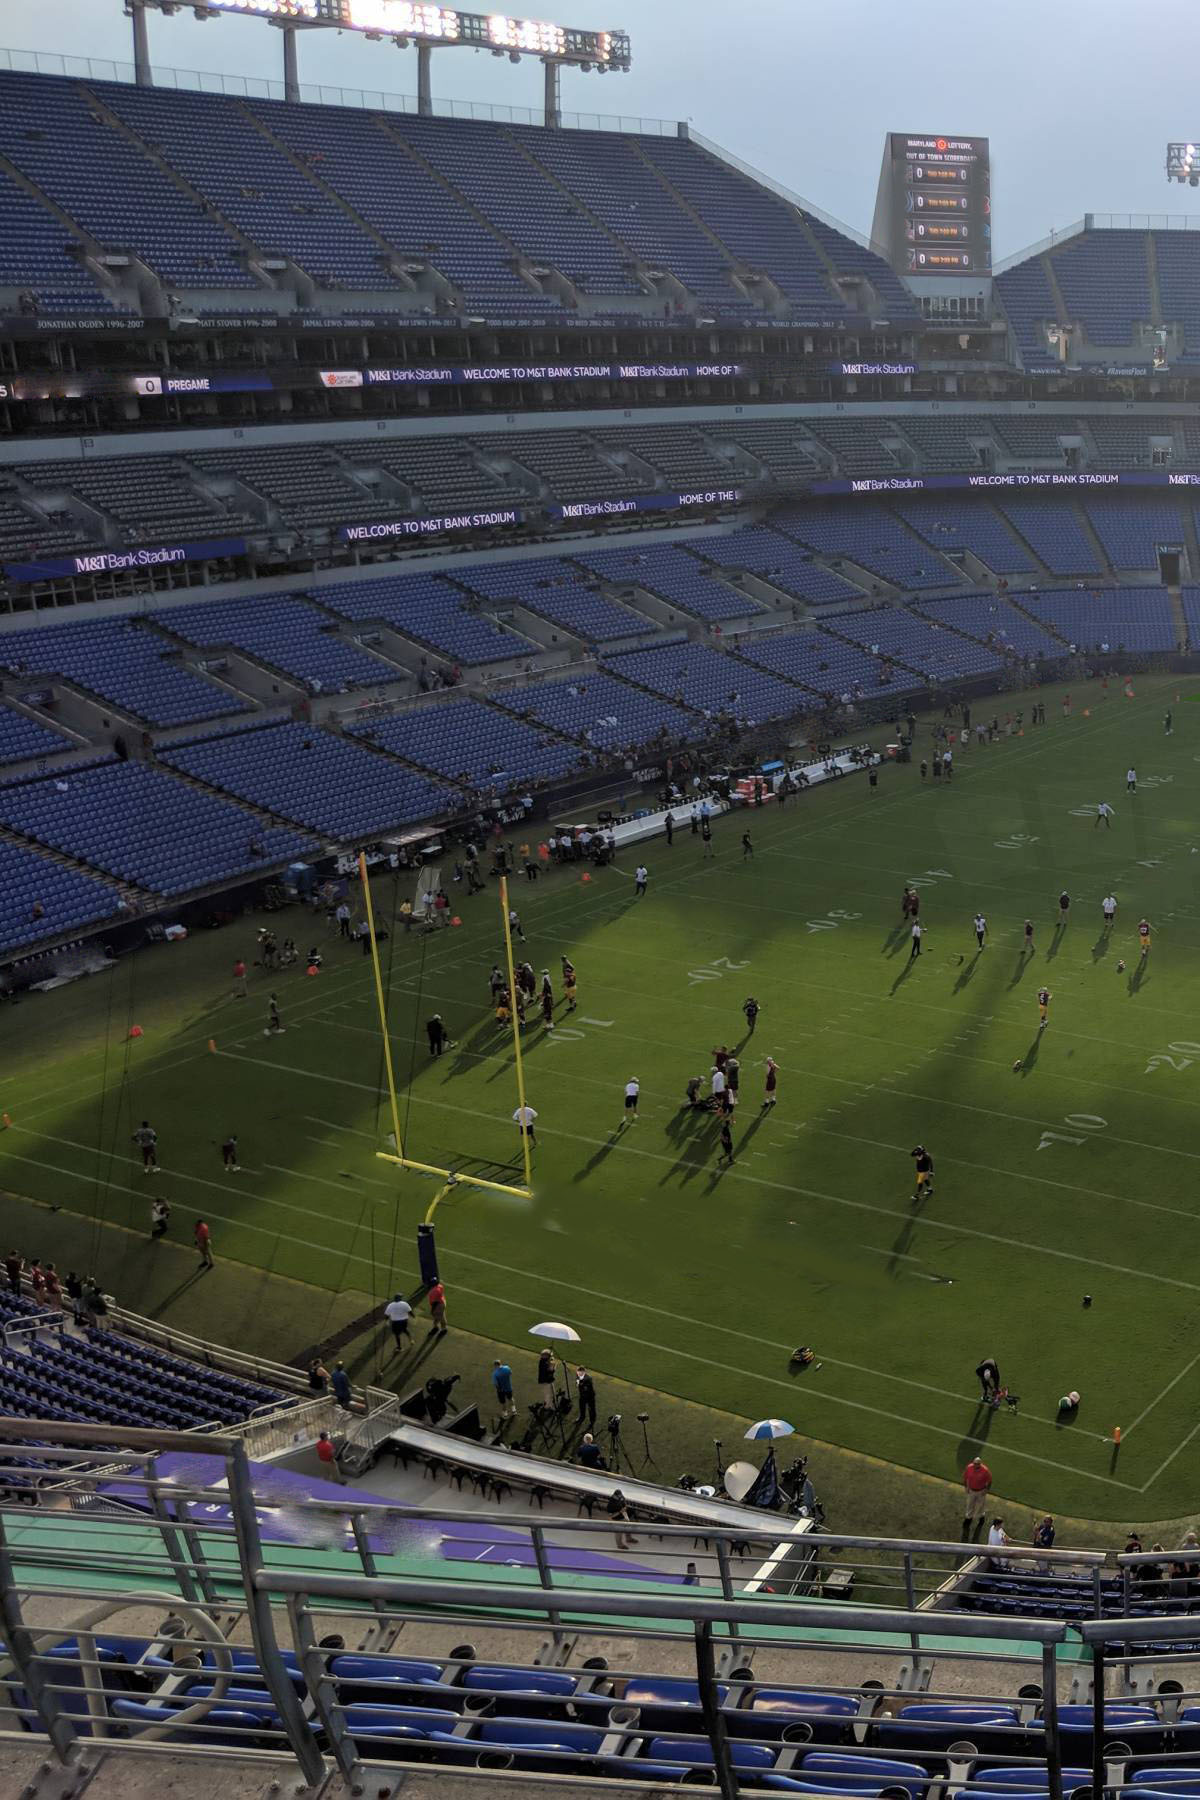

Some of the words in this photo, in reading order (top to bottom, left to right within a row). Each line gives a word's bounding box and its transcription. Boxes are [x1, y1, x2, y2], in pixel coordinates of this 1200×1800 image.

[907, 140, 936, 148] MARYLAND
[906, 152, 917, 160] OUT
[927, 153, 943, 161] TOWN
[917, 167, 923, 178] 0
[961, 169, 967, 180] 0
[917, 196, 924, 207] 0
[961, 198, 968, 208] 0
[918, 224, 925, 236] 0
[962, 226, 968, 237] 0
[919, 253, 926, 264] 0
[962, 255, 969, 265] 0
[37, 320, 77, 328] JONATHAN
[79, 320, 105, 328] OGDEN
[368, 369, 391, 381] M&T
[391, 369, 416, 381] Bank
[414, 368, 452, 380] Stadium
[463, 368, 511, 379] WELCOME
[512, 368, 525, 378] TO
[526, 367, 547, 378] M&T
[548, 366, 573, 378] BANK
[573, 366, 610, 377] STADIUM
[620, 365, 640, 377] M&T
[640, 365, 659, 377] Bank
[658, 365, 688, 377] Stadium
[696, 365, 720, 377] HOME
[721, 365, 733, 376] OF
[842, 363, 863, 374] M&T
[863, 363, 883, 374] Bank
[883, 363, 915, 374] Stadium
[145, 380, 155, 392] 0
[167, 379, 210, 391] PREGAME
[852, 480, 873, 492] M&T
[872, 479, 891, 490] Bank
[890, 477, 923, 489] Stadium
[969, 475, 1015, 486] WELCOME
[1016, 475, 1030, 484] TO
[1031, 474, 1051, 484] M&T
[1052, 474, 1078, 484] BANK
[1078, 474, 1119, 484] STADIUM
[1168, 474, 1191, 485] M&T
[679, 492, 704, 506] HOME
[704, 491, 717, 503] OF
[717, 490, 735, 502] THE
[562, 503, 584, 517] M&T
[584, 501, 605, 515] Bank
[604, 500, 637, 513] Stadium
[347, 523, 402, 540] WELCOME
[403, 520, 419, 533] TO
[420, 518, 443, 532] M&T
[444, 515, 472, 530] BANK
[473, 511, 516, 526] STADIUM
[75, 553, 108, 573] M&T
[108, 552, 139, 569] Bank
[138, 547, 185, 567] Stadium
[805, 909, 864, 930] 30
[687, 956, 751, 981] 20
[547, 1016, 616, 1042] 10
[1039, 1113, 1109, 1147] 10
